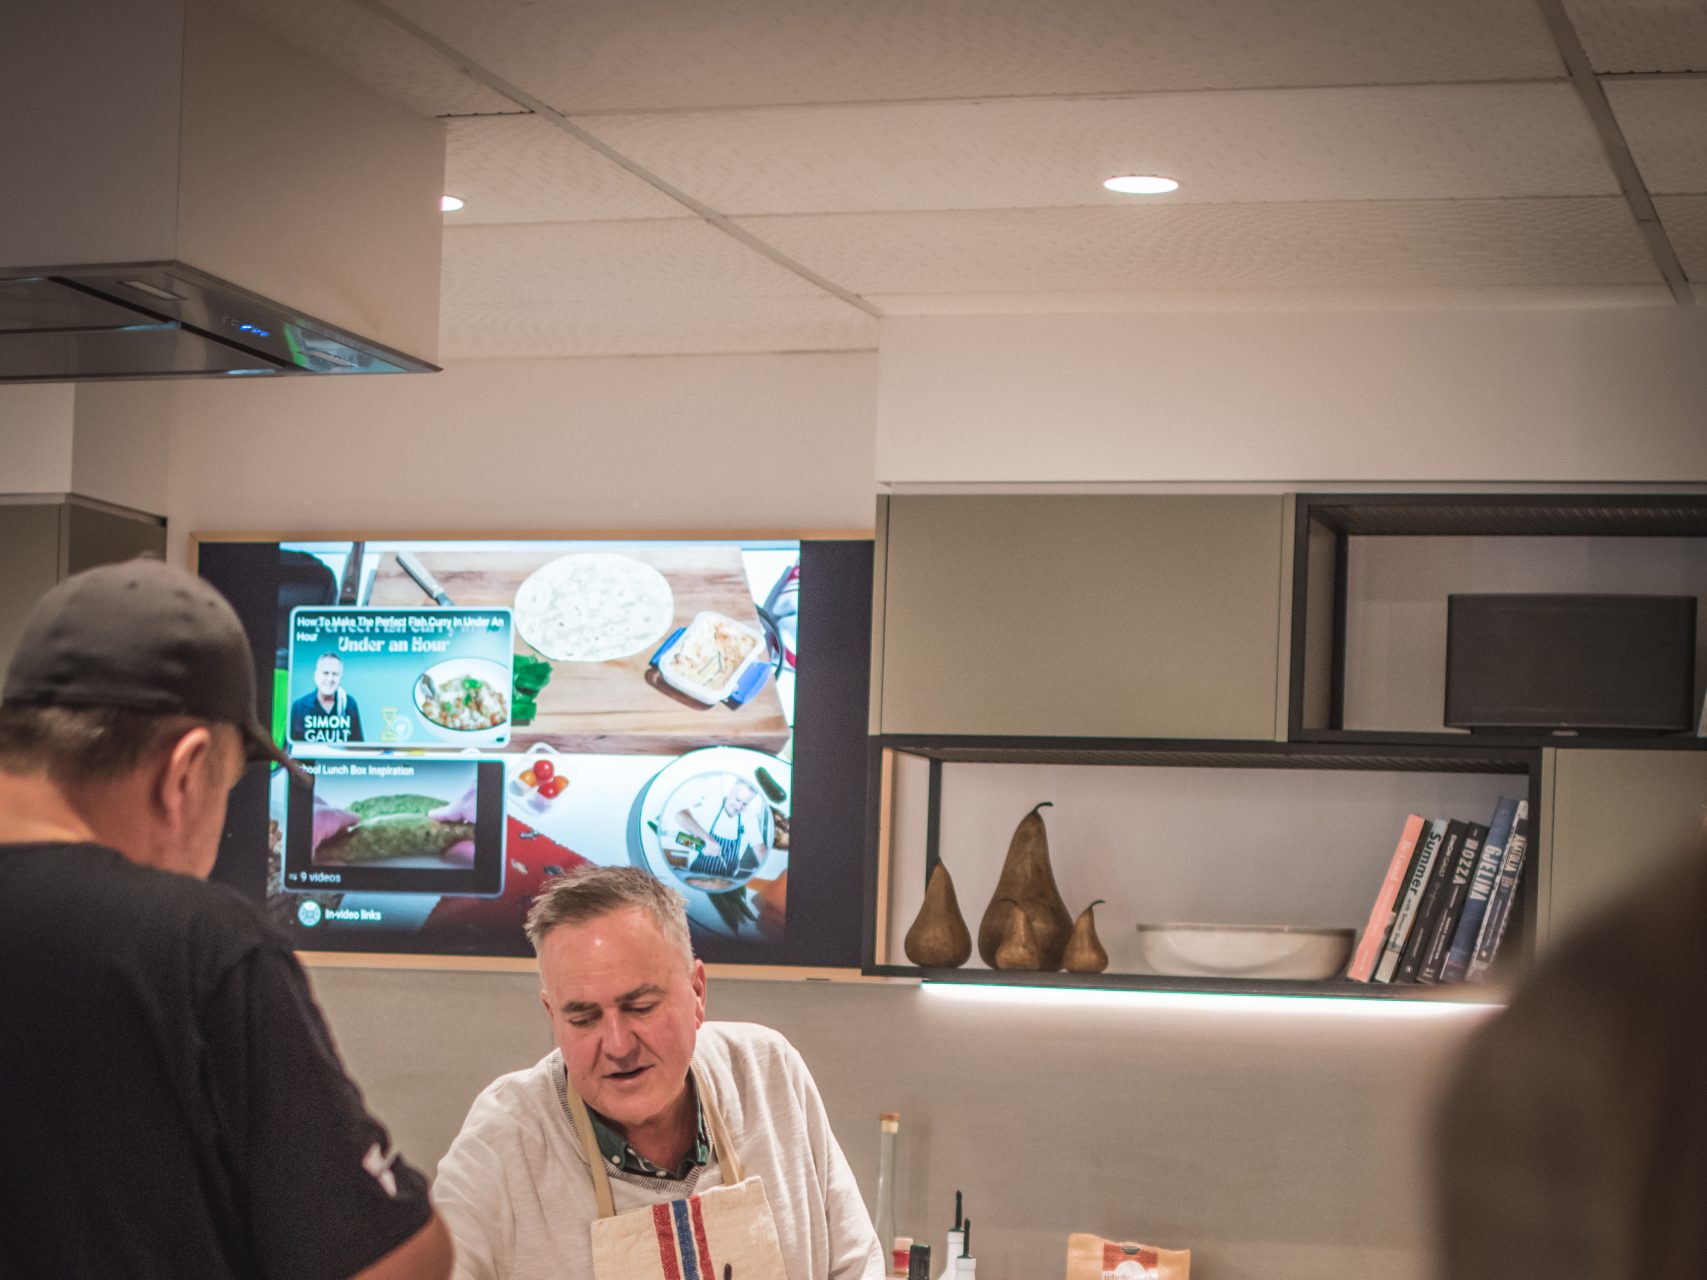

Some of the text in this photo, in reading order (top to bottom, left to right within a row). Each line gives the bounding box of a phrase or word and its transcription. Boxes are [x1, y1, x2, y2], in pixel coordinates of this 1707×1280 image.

[297, 616, 504, 629] How To Make The Perfect Fish Curry In Under An
[296, 631, 318, 641] Hour
[338, 636, 450, 652] Under an Hour
[304, 715, 351, 729] SIMON
[304, 729, 351, 743] GAULT
[322, 764, 348, 775] Lunch
[350, 765, 367, 775] Box
[368, 765, 415, 777] Inspiration
[1408, 831, 1442, 896] Summer
[1453, 838, 1479, 885] MOZZA
[300, 872, 342, 883] 9 videos
[1469, 844, 1502, 901] GJELINA
[325, 908, 382, 920] In-video links
